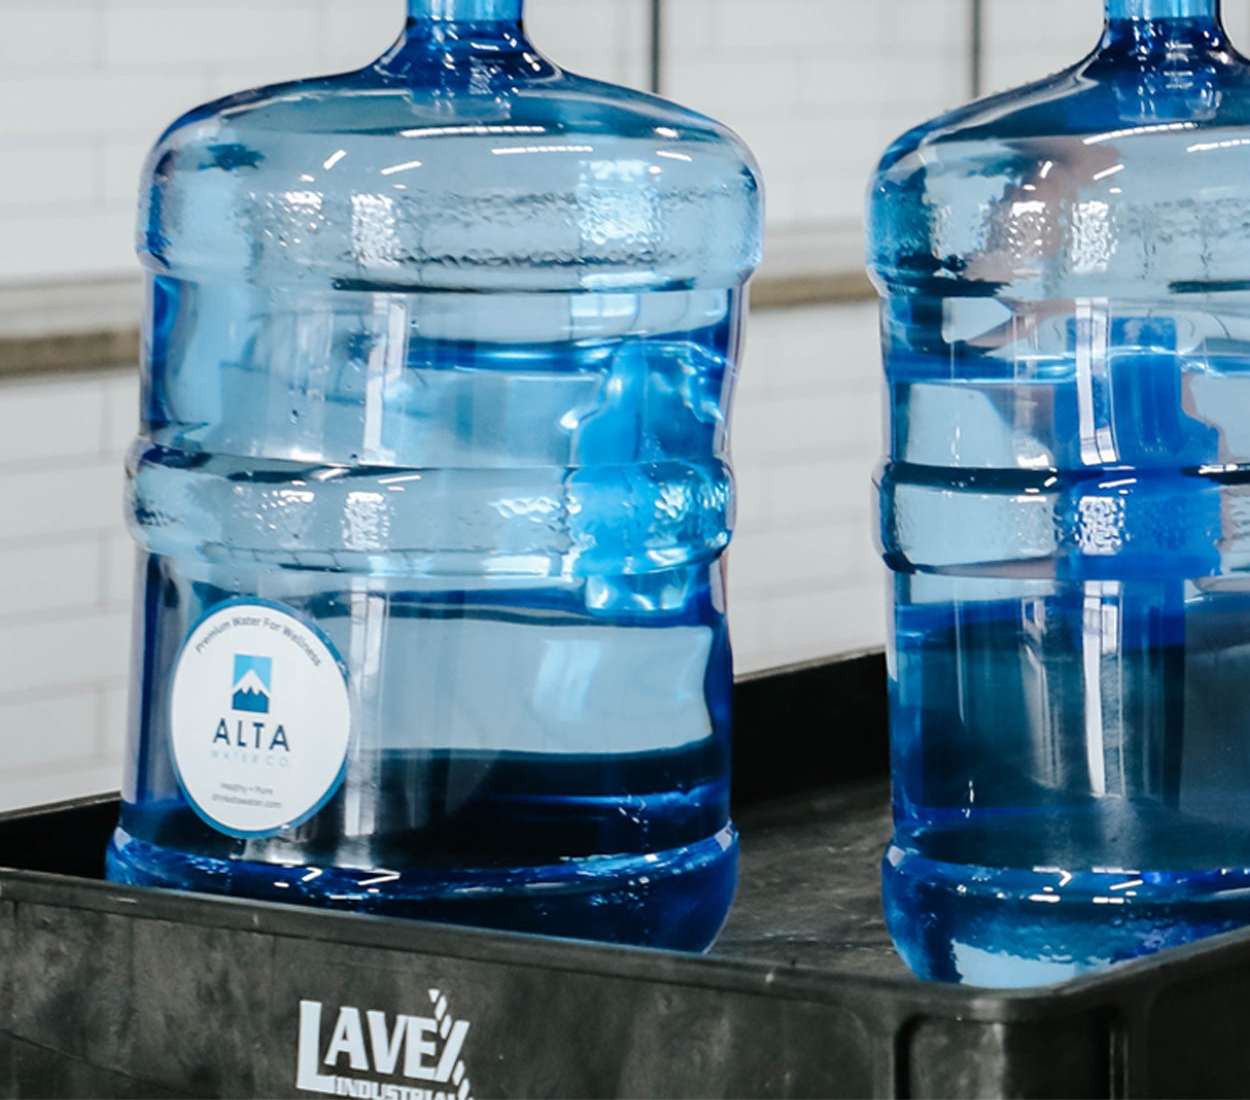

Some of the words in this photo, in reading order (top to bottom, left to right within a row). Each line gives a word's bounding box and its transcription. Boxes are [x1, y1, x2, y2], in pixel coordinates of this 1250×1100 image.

[194, 620, 232, 655] Premium
[231, 615, 262, 627] Water
[262, 617, 282, 632] For
[282, 625, 322, 667] Wellness
[212, 717, 291, 753] ALTA
